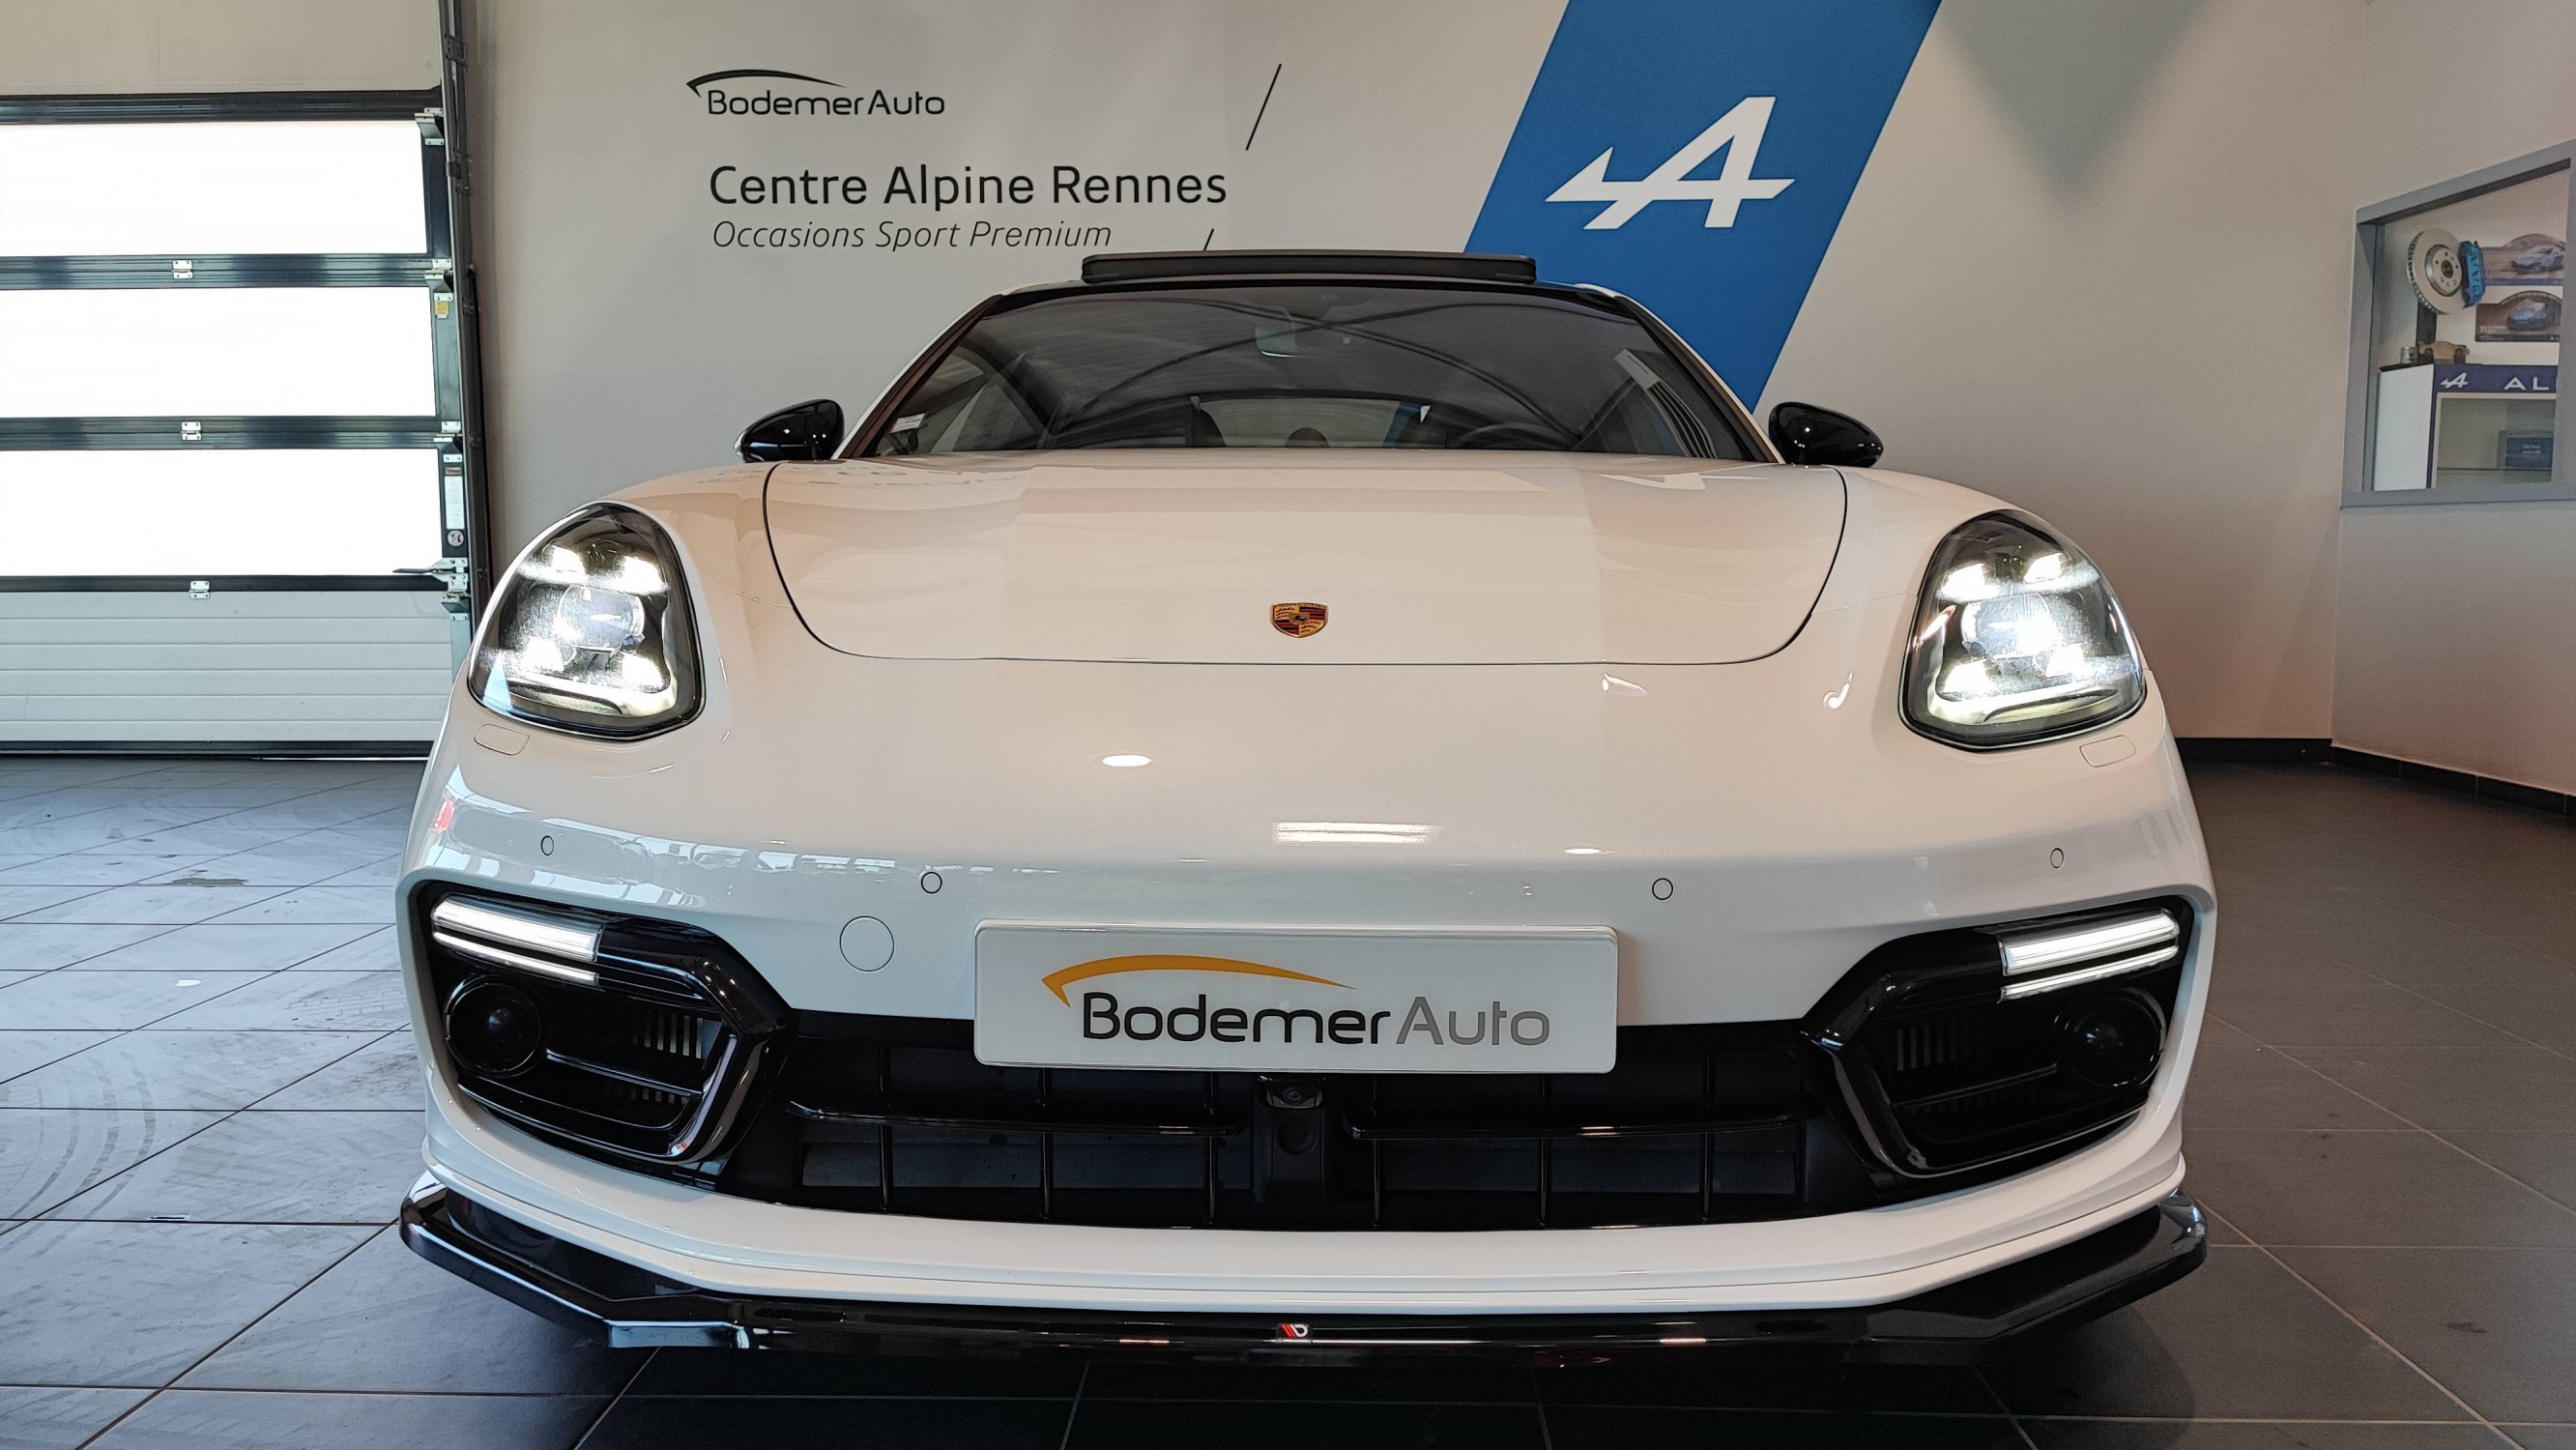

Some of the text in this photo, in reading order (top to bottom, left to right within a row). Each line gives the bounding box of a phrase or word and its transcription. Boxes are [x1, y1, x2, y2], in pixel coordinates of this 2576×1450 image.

[709, 163, 1227, 212] Centre Alpine Rennes
[712, 219, 1112, 252] Occasions Sport Premium
